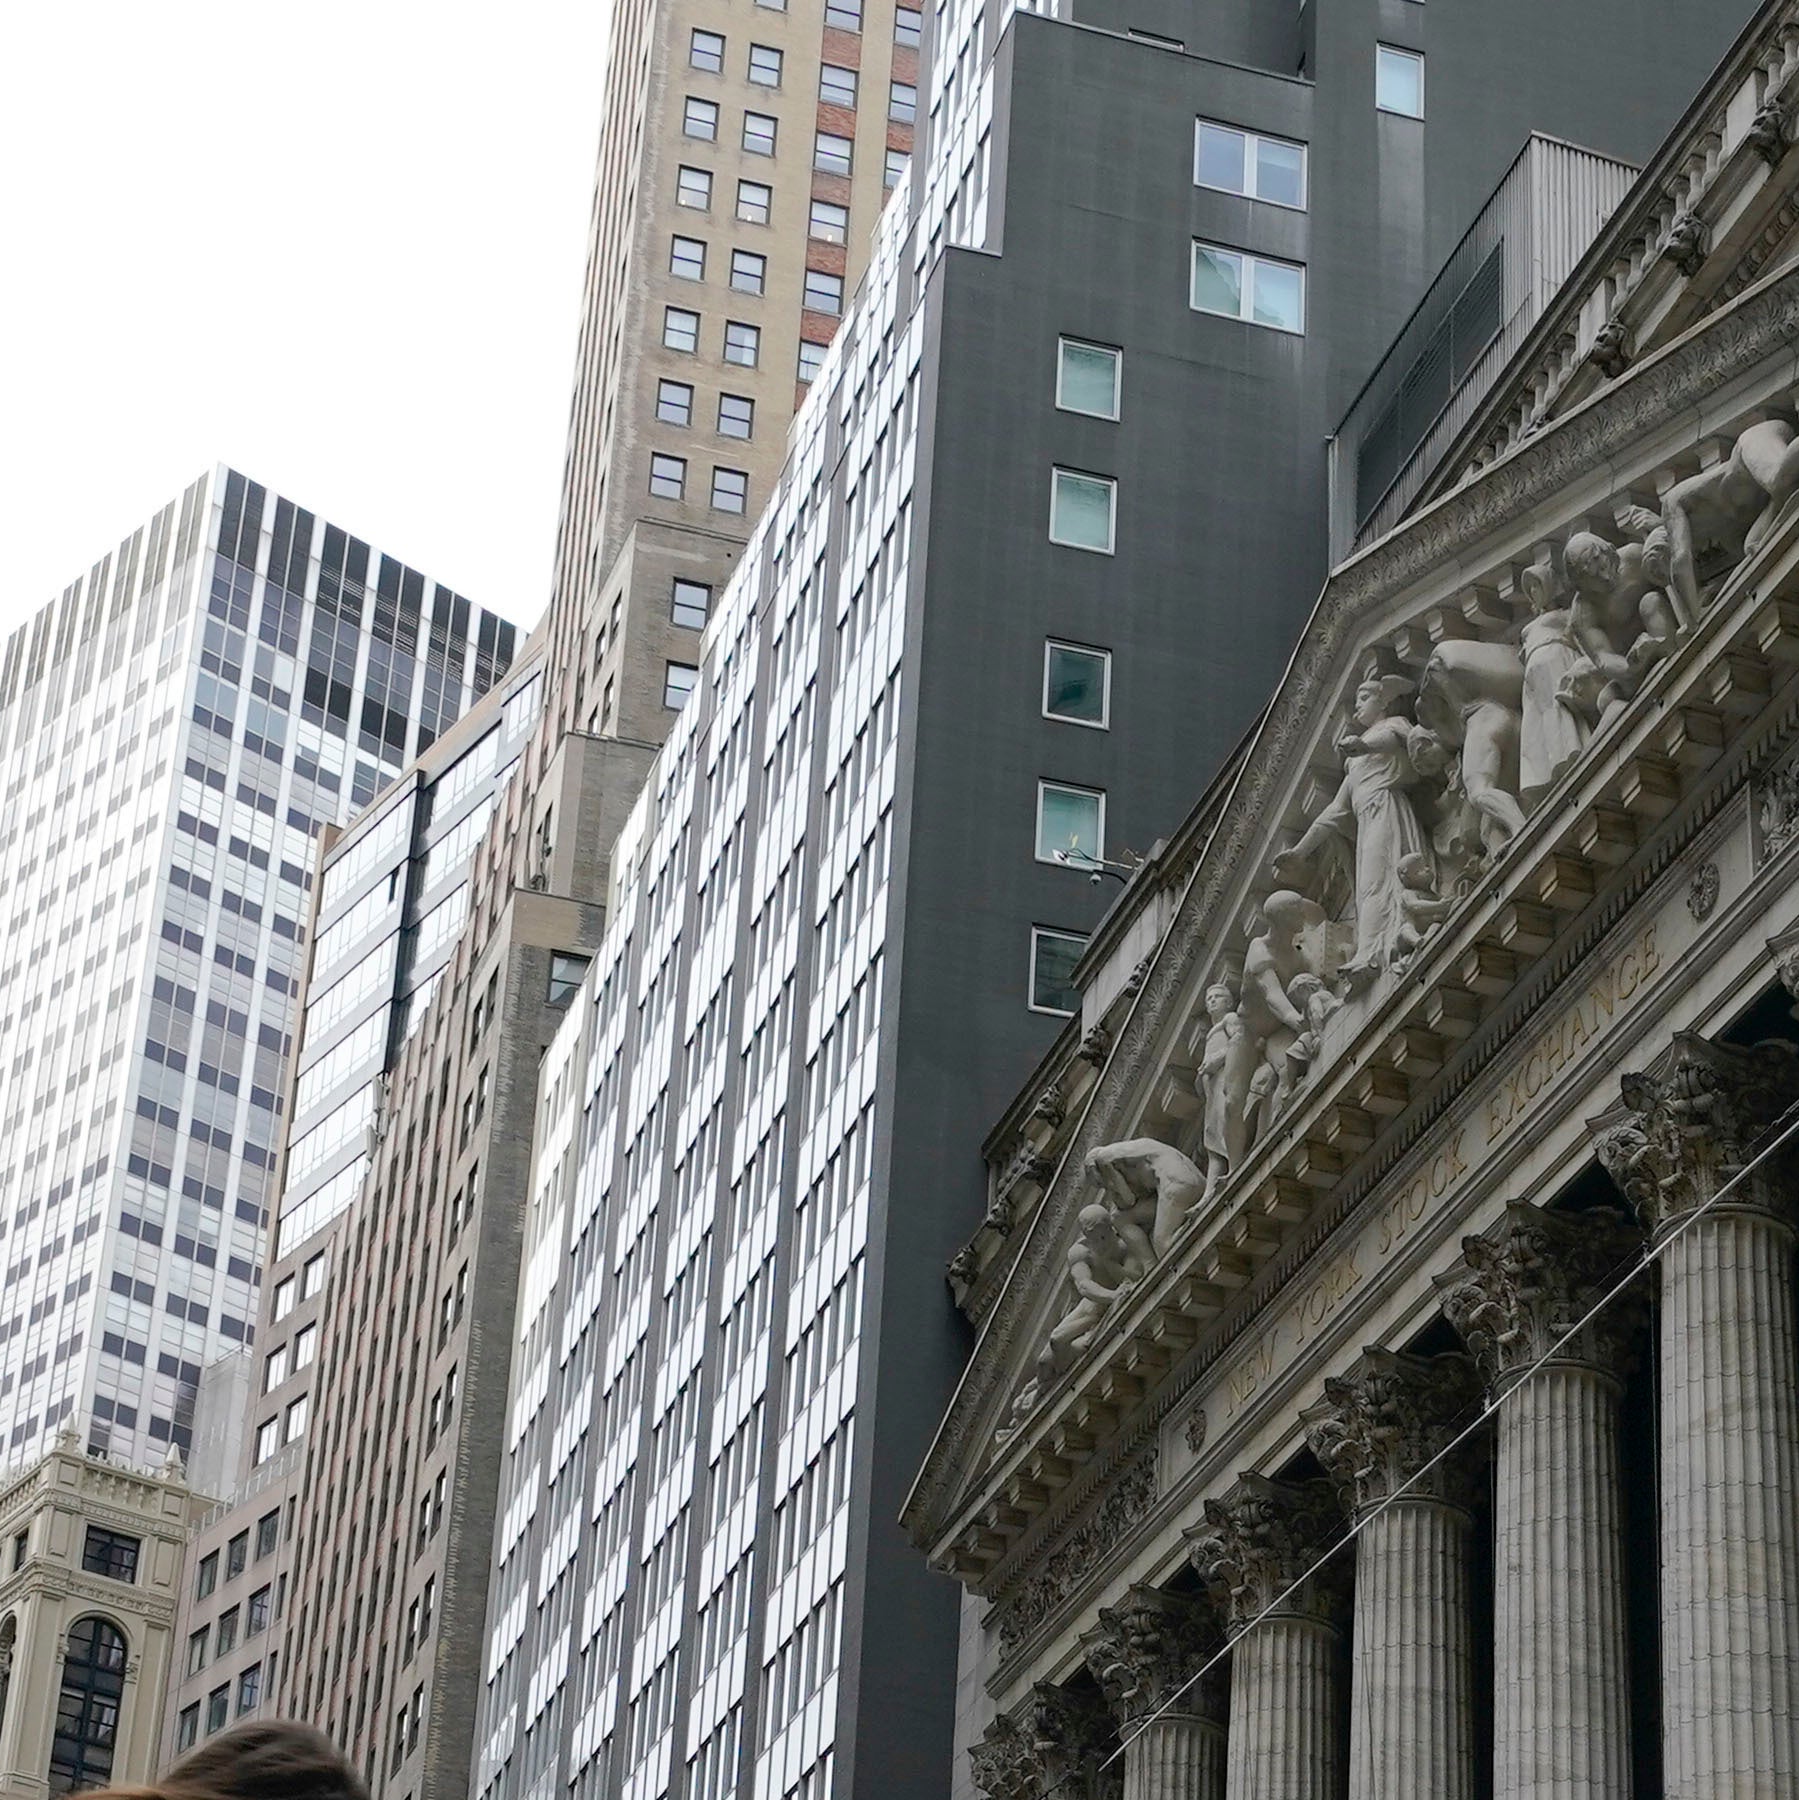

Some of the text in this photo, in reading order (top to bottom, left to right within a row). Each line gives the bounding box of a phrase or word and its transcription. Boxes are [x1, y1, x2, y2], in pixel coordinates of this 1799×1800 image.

[1226, 922, 1661, 1417] NEW YORK STOCK EXCHANGE
